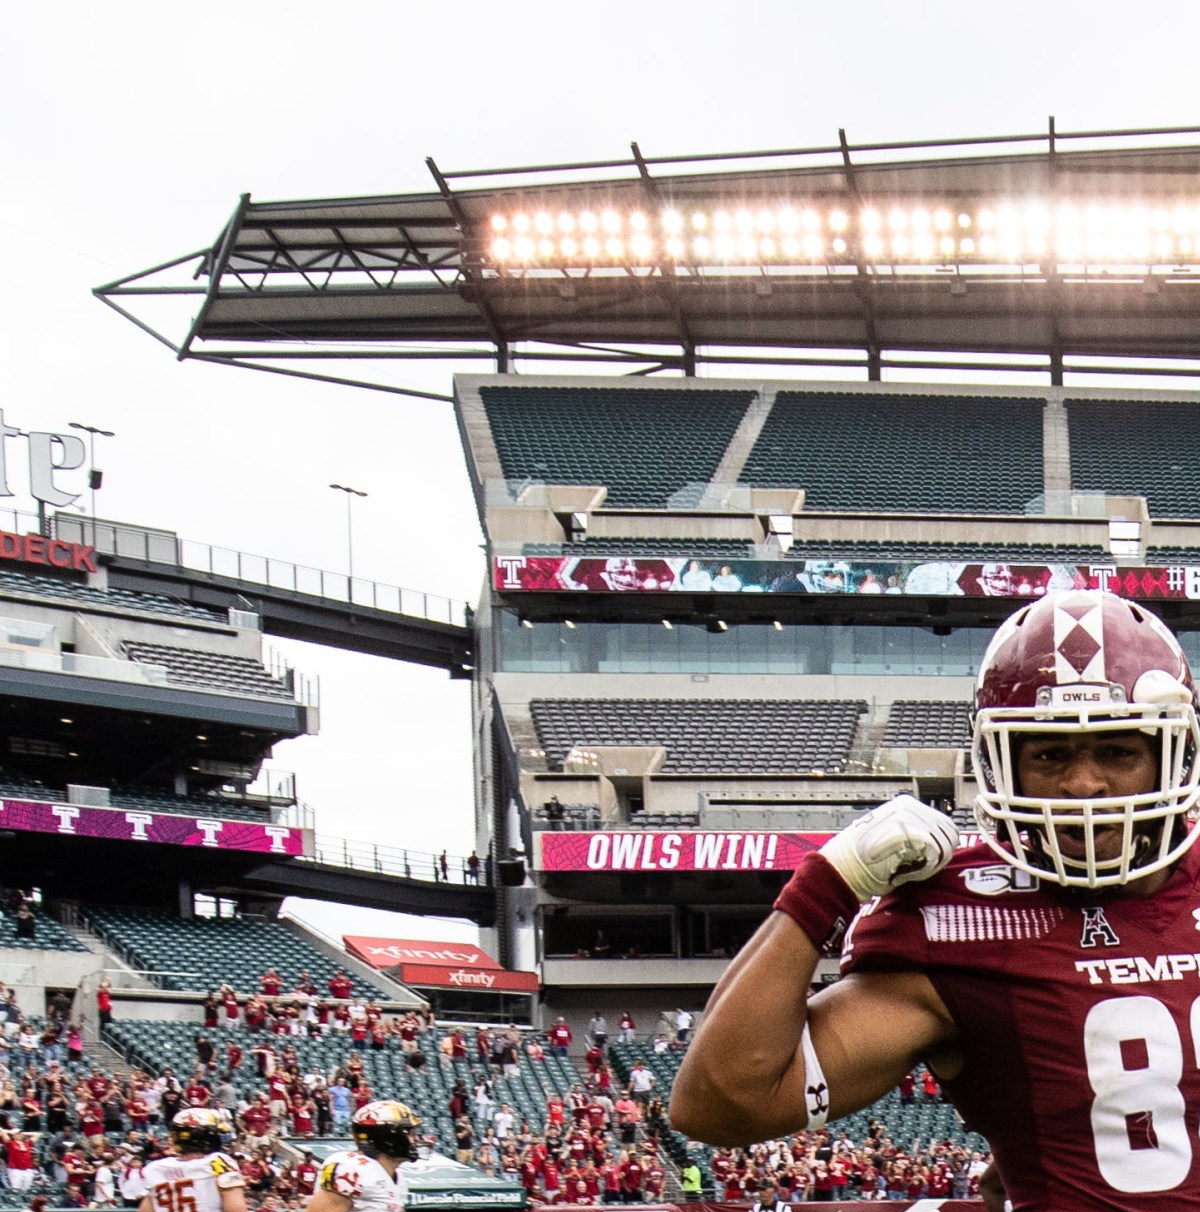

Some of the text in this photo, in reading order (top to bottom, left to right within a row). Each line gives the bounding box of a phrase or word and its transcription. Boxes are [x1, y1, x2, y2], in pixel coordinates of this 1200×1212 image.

[1062, 692, 1100, 702] OWLS
[586, 834, 778, 869] OWLS WIN!
[366, 946, 480, 964] xfinity
[449, 970, 496, 988] xfinity
